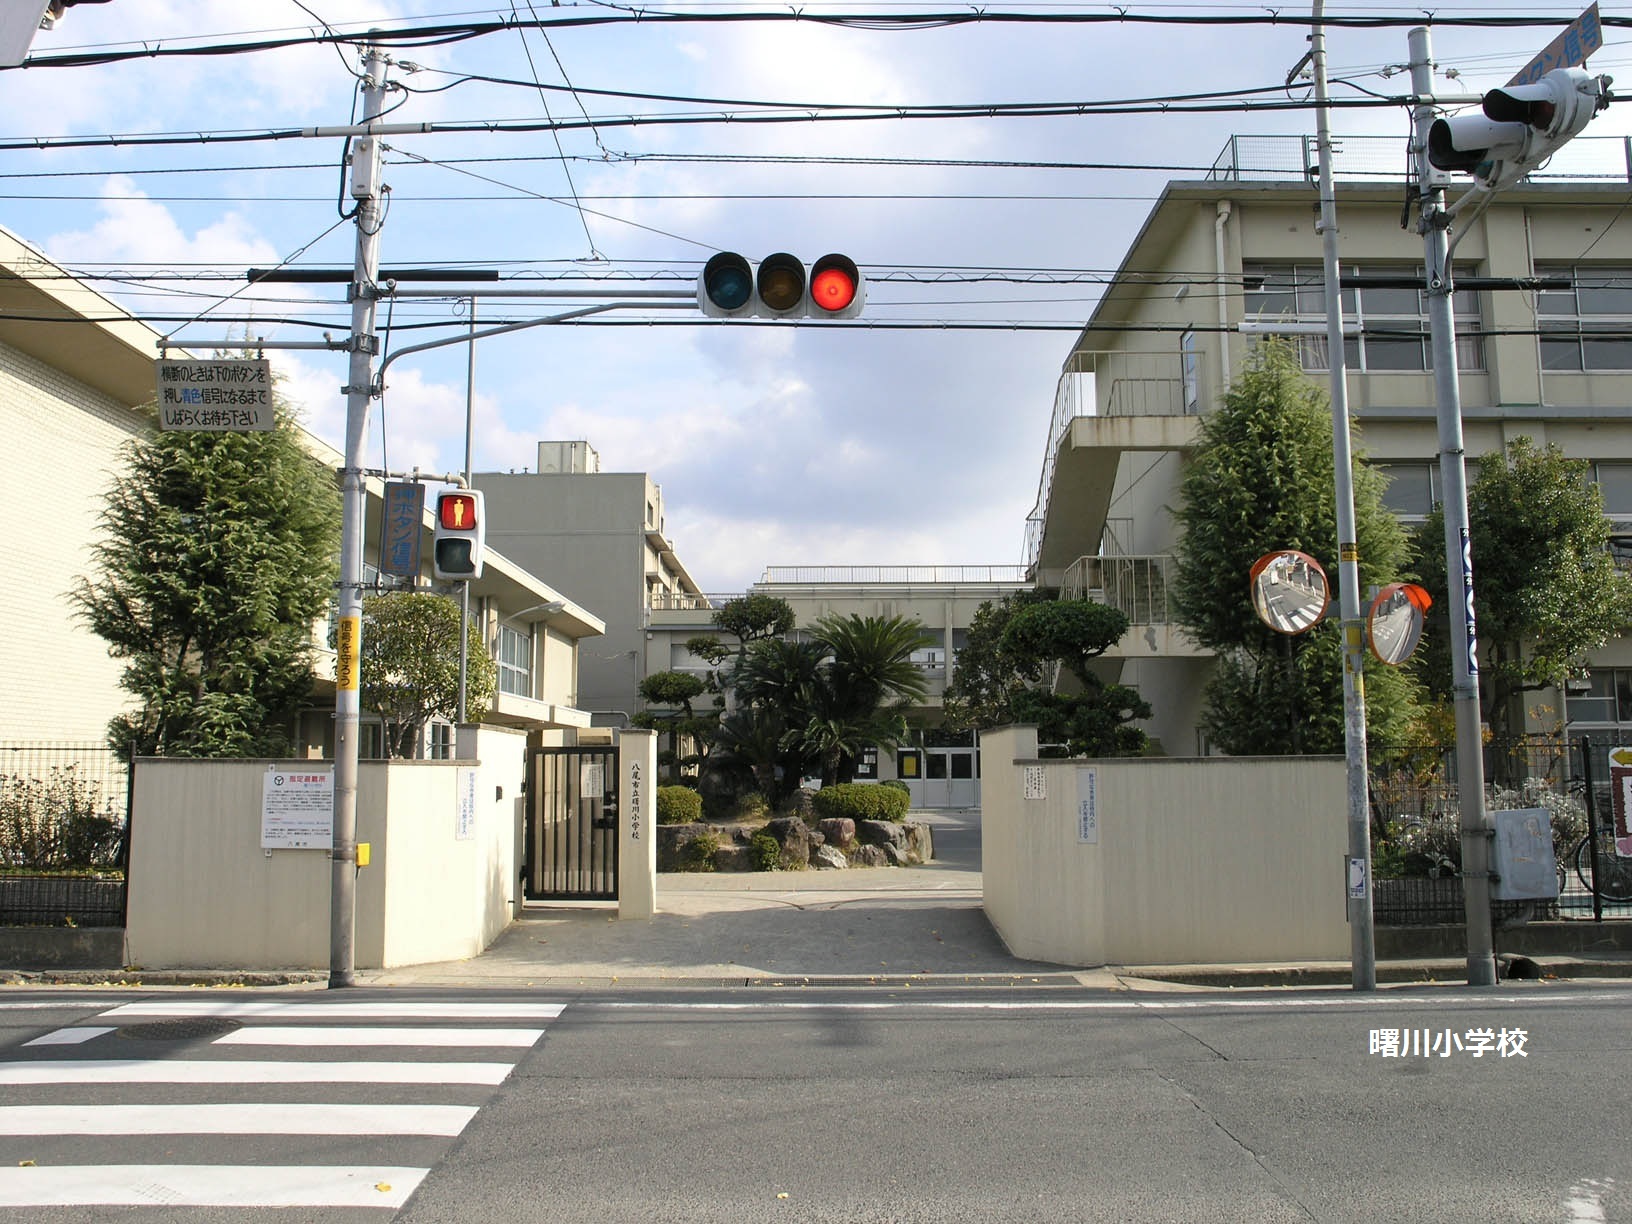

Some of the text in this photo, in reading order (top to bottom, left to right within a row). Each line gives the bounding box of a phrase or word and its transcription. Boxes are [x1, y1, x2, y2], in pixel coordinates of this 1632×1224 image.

[161, 366, 265, 382] 横断のときは下のボタンを
[164, 388, 267, 405] 押し青色信号になるまで
[165, 408, 259, 426] しばらくお待ち下さい
